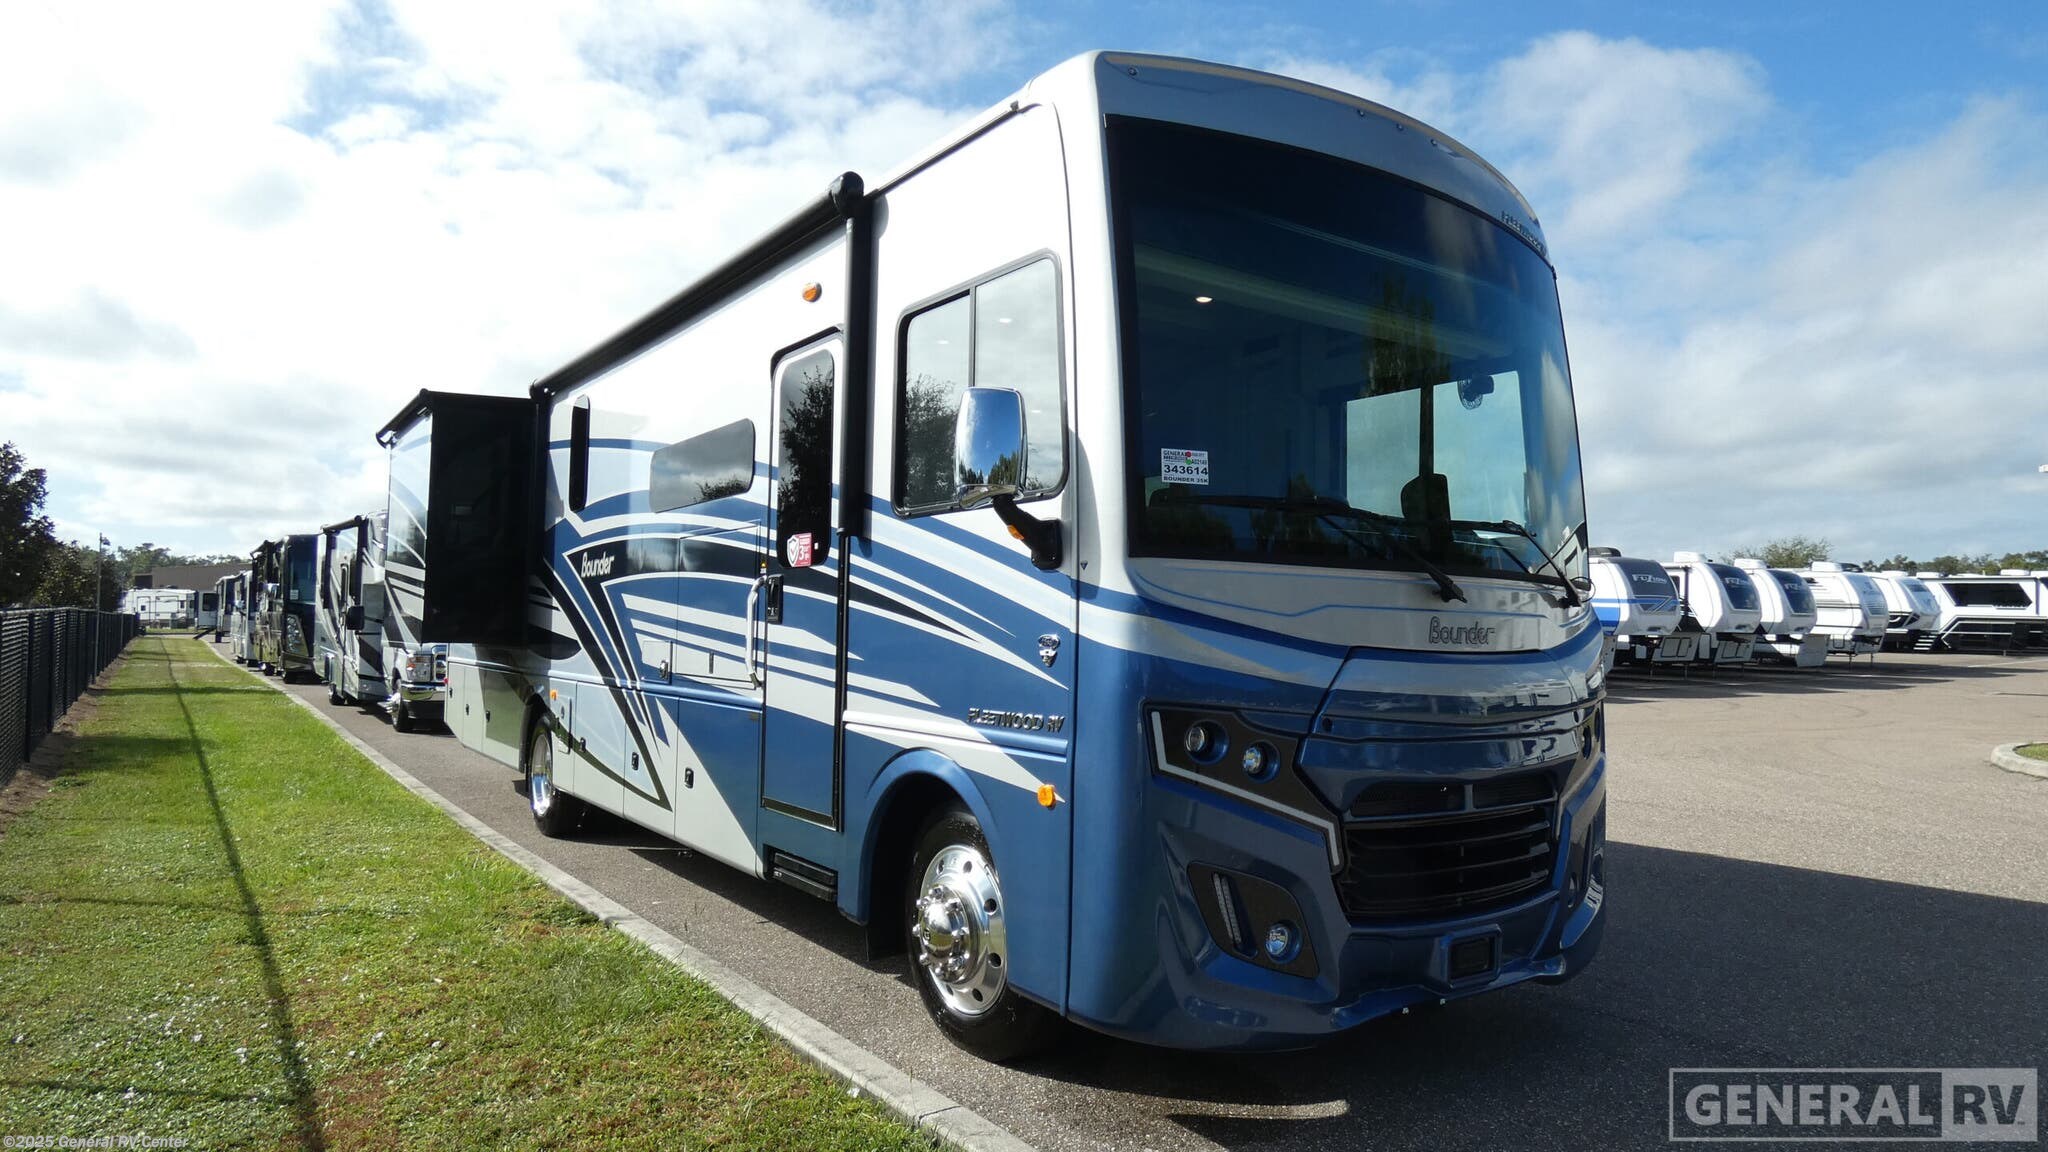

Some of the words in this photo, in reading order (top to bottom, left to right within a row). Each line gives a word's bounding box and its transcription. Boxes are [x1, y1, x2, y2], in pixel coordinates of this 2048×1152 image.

[1164, 464, 1209, 476] 343614
[580, 551, 615, 578] Bounder
[1428, 615, 1496, 645] Bounder
[967, 707, 1044, 731] FLEETWOOD
[1046, 714, 1065, 733] RV
